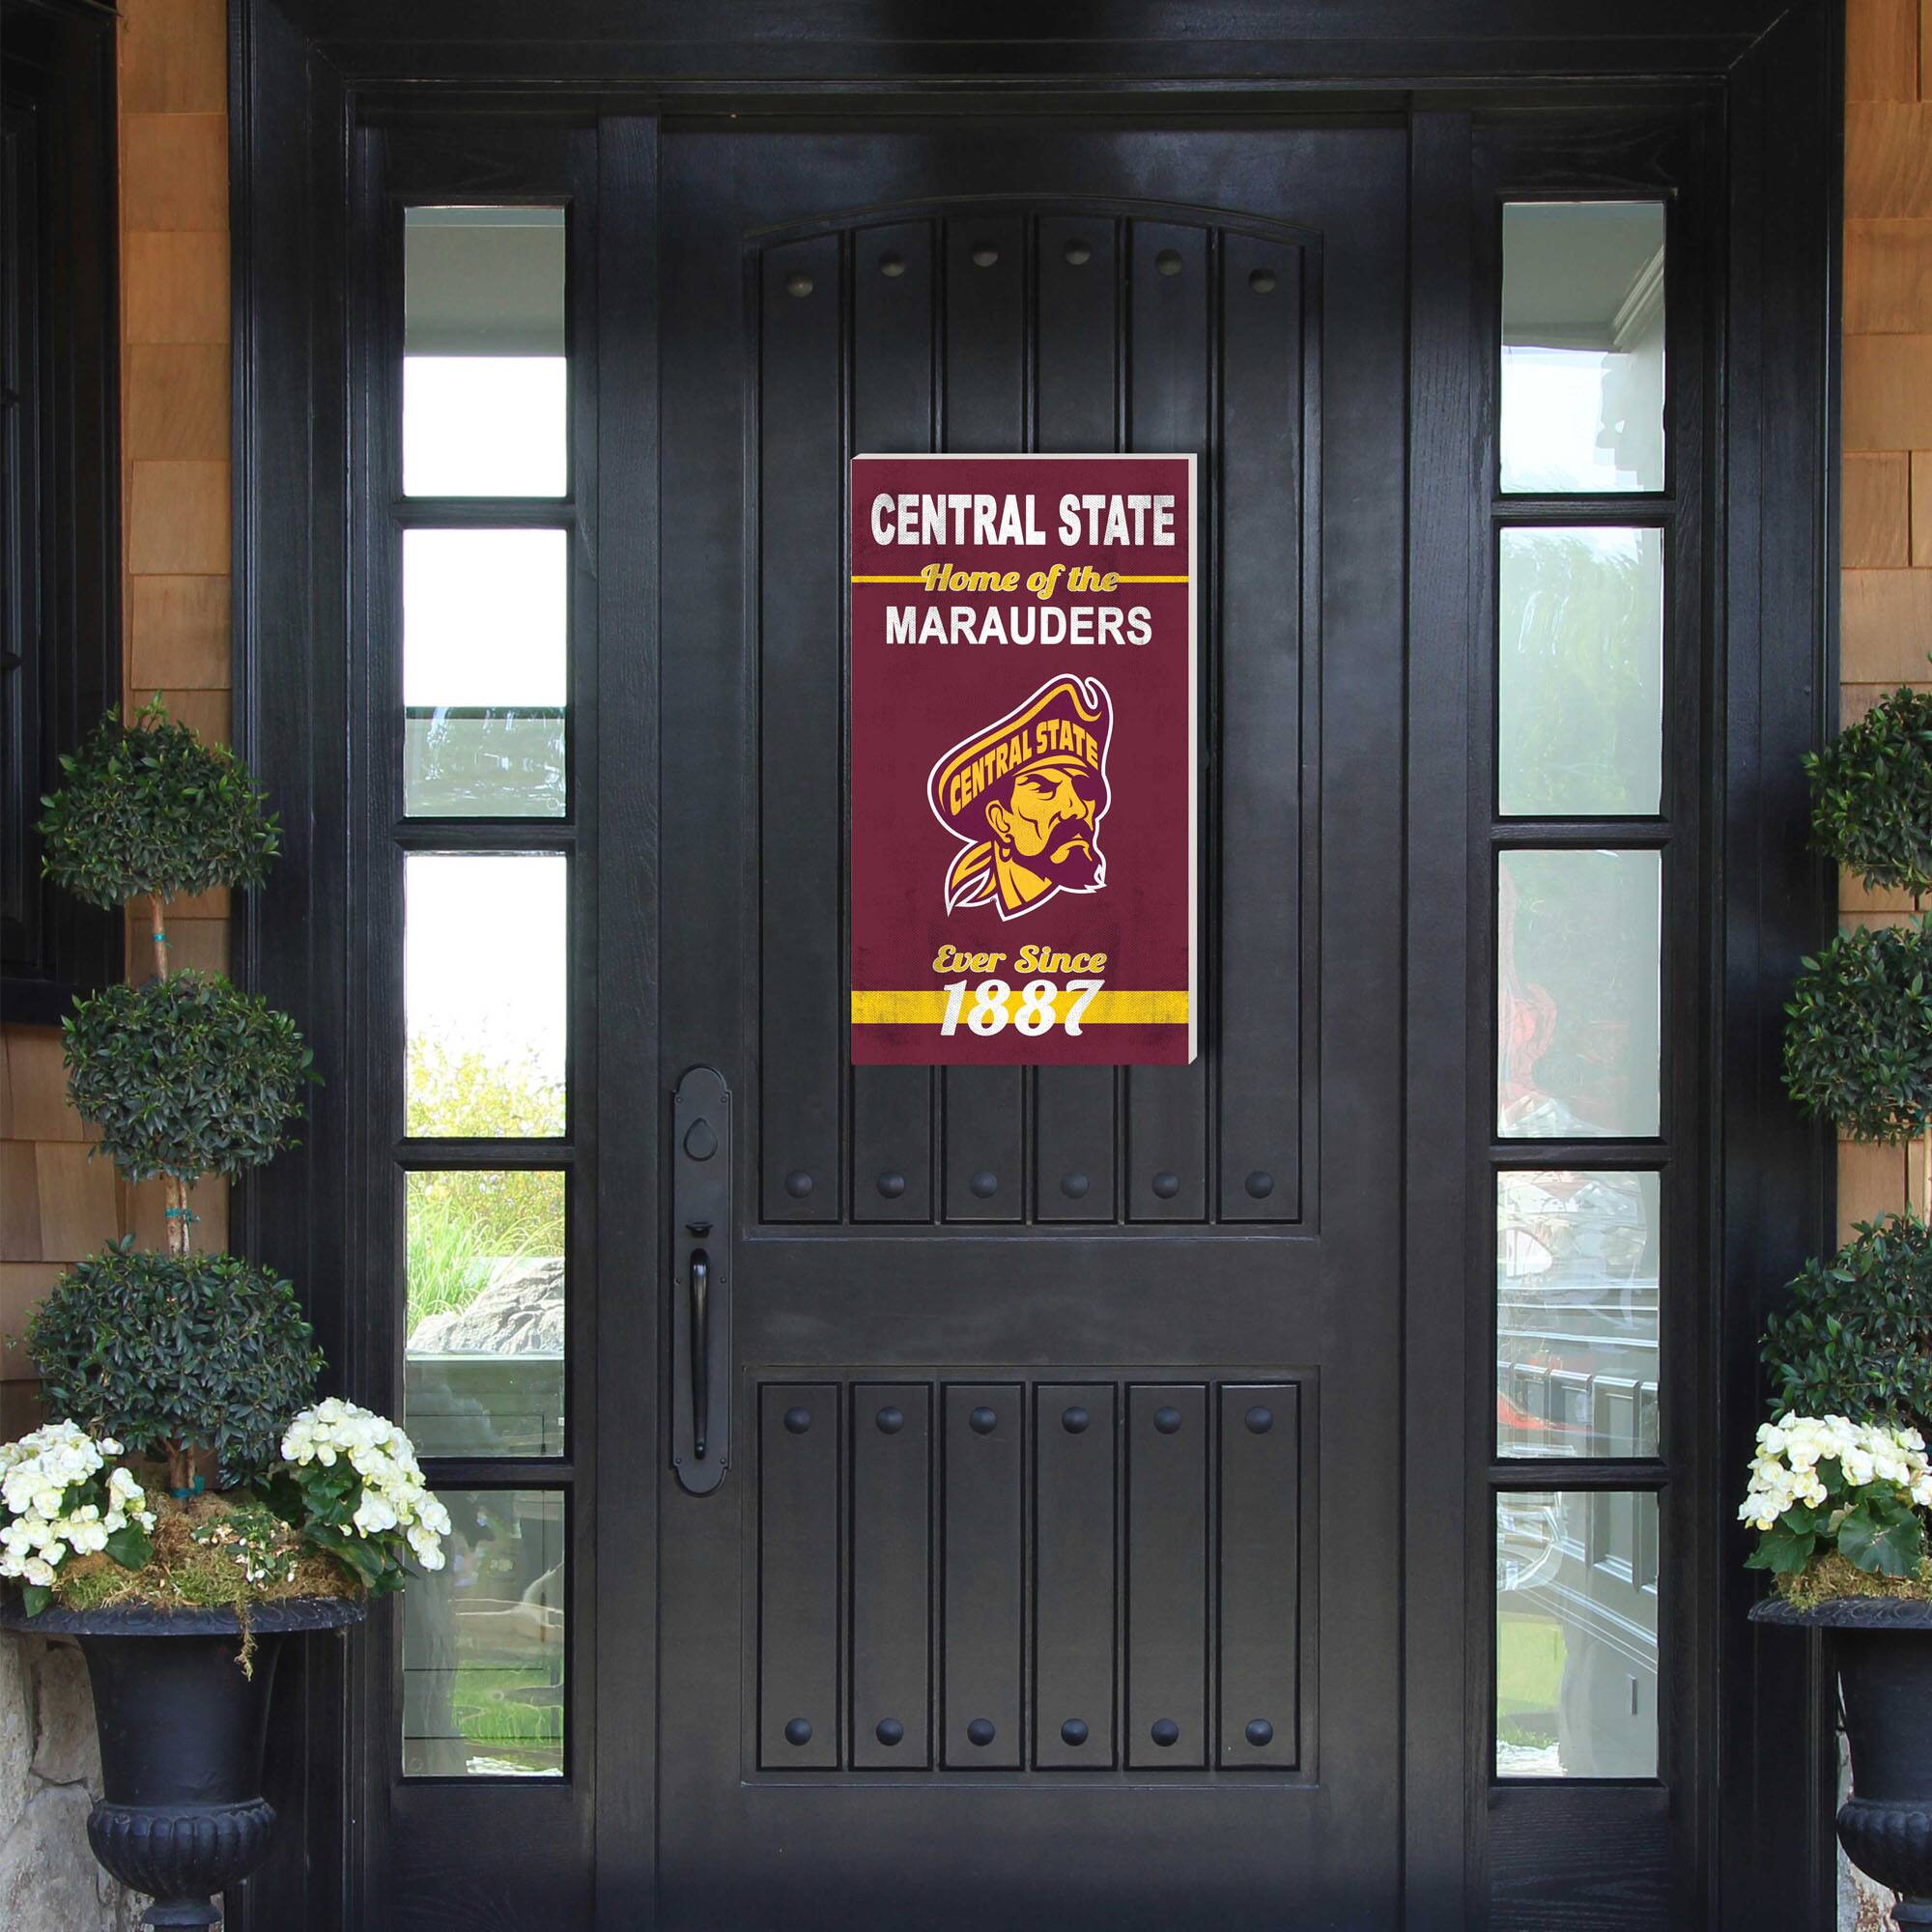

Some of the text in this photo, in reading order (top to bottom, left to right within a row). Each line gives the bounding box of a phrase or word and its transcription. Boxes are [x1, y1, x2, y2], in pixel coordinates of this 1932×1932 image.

[871, 493, 1176, 546] CENTRAL STATE
[921, 563, 1120, 600] Home of the
[886, 606, 1152, 645] MARAUDERS
[950, 718, 1098, 816] CENTRAL STATE
[932, 944, 1107, 974] Ever Since
[940, 979, 1106, 1037] 1887
